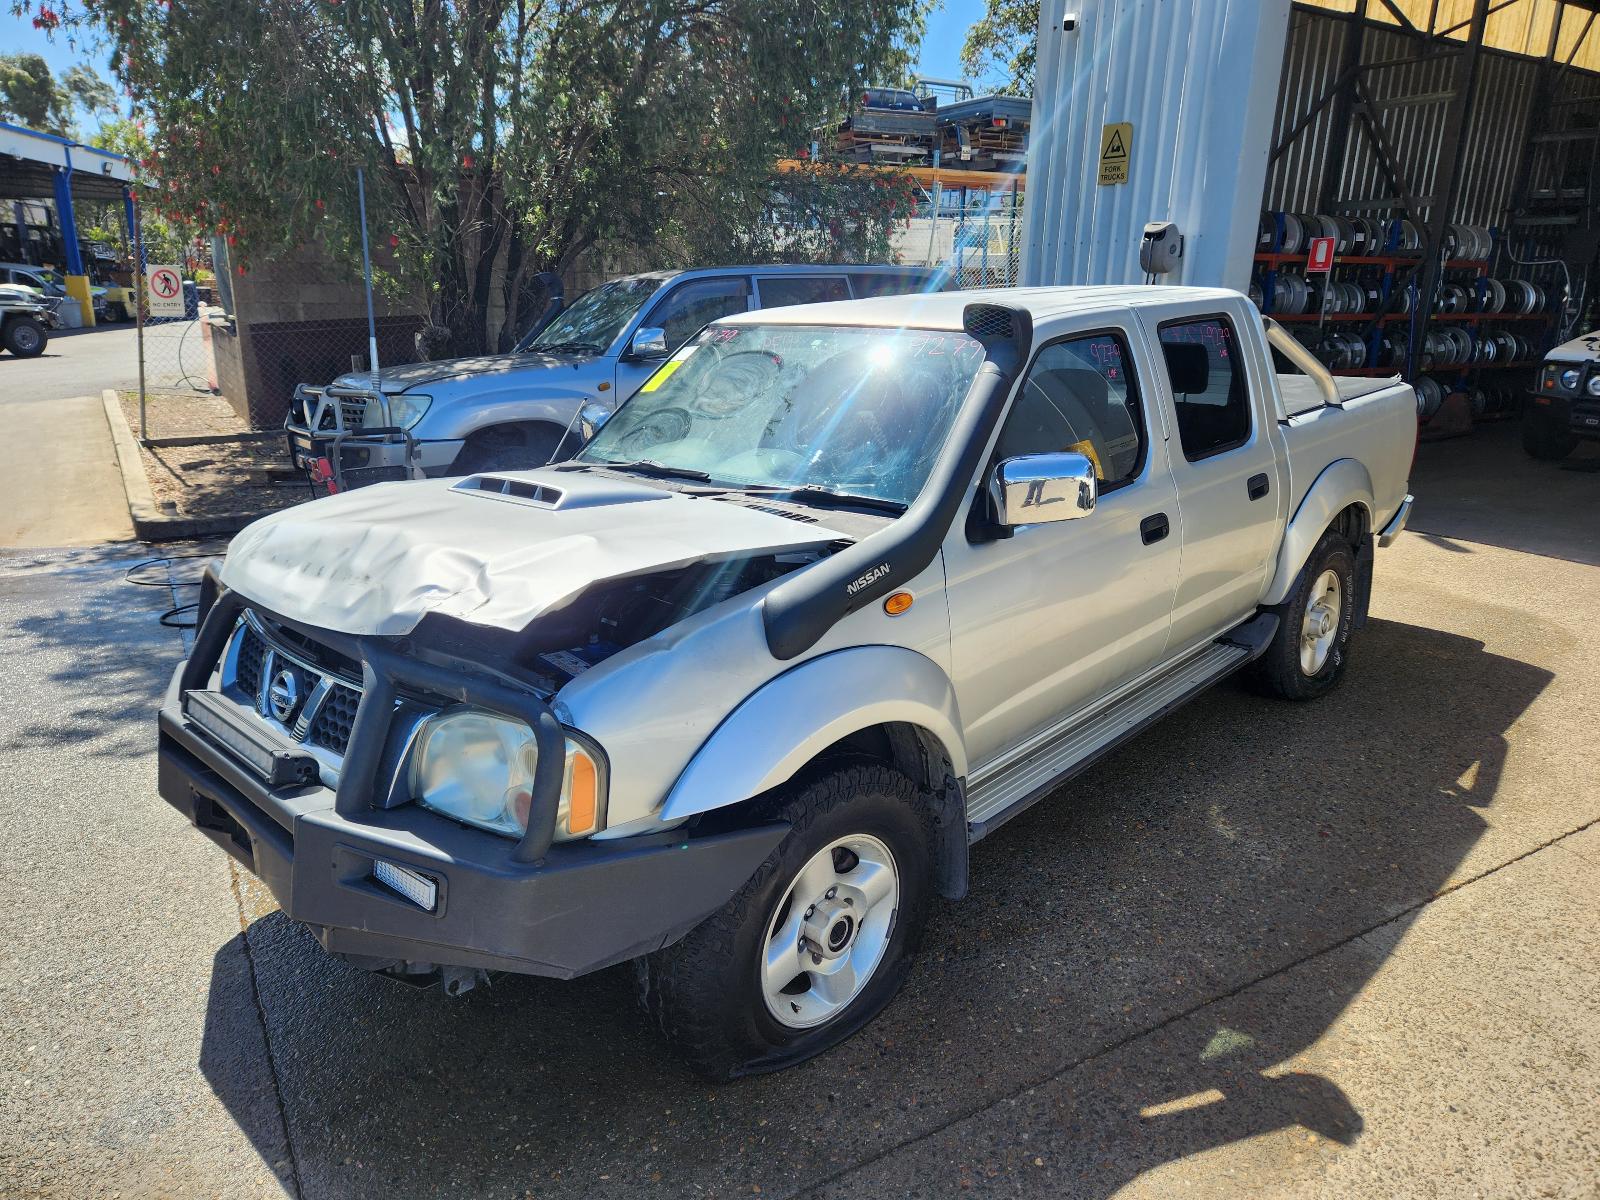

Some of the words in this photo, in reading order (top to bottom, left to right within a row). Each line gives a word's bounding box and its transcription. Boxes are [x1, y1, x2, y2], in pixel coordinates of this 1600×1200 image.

[1104, 165, 1121, 173] FORK
[1101, 173, 1125, 181] TRUCKS
[847, 562, 891, 595] NISSAN
